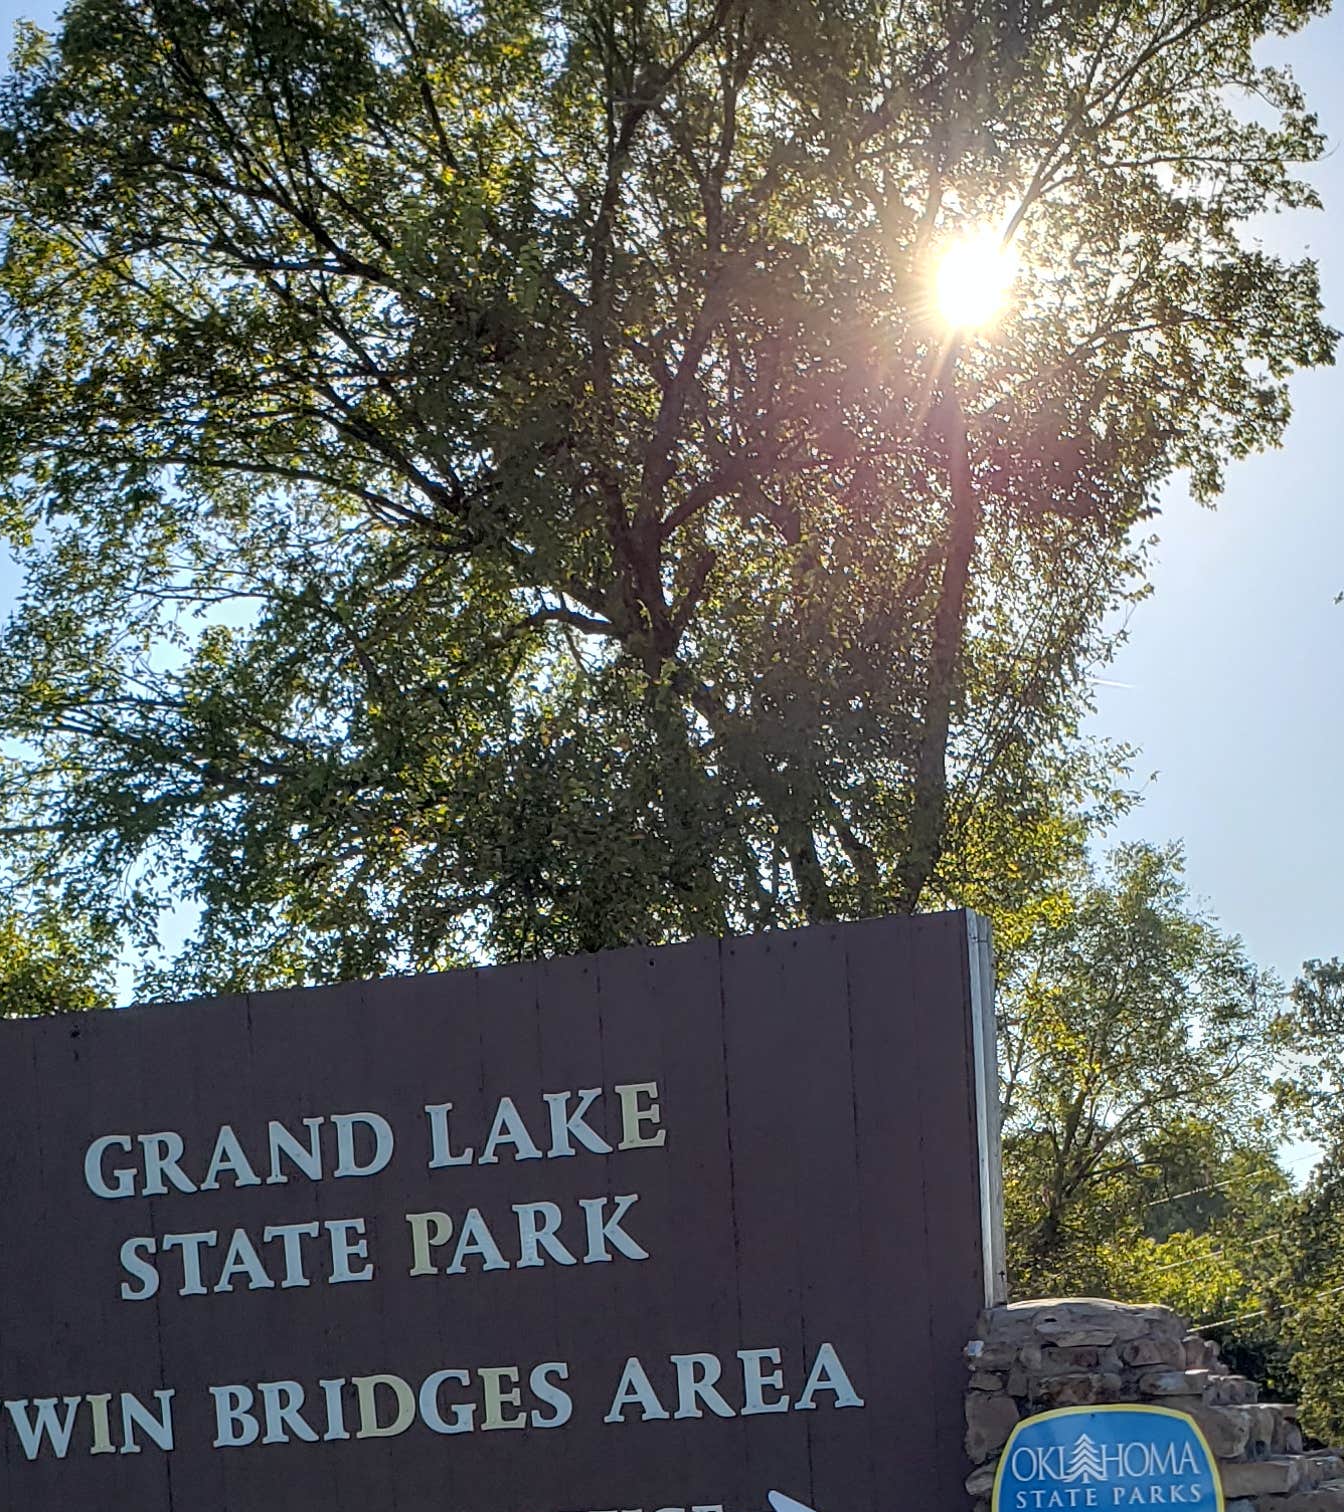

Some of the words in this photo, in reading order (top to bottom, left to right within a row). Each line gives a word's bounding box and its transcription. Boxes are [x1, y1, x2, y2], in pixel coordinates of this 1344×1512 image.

[84, 1111, 395, 1199] GRAND
[428, 1082, 667, 1168] LAKE
[119, 1217, 375, 1301] STATE
[406, 1193, 650, 1277] PARK
[209, 1361, 574, 1449] BRIDGES
[603, 1342, 866, 1424] AREA
[1011, 1433, 1202, 1484] OKLAHOMA
[1016, 1488, 1098, 1509] STATE
[1113, 1484, 1203, 1505] PARKS
